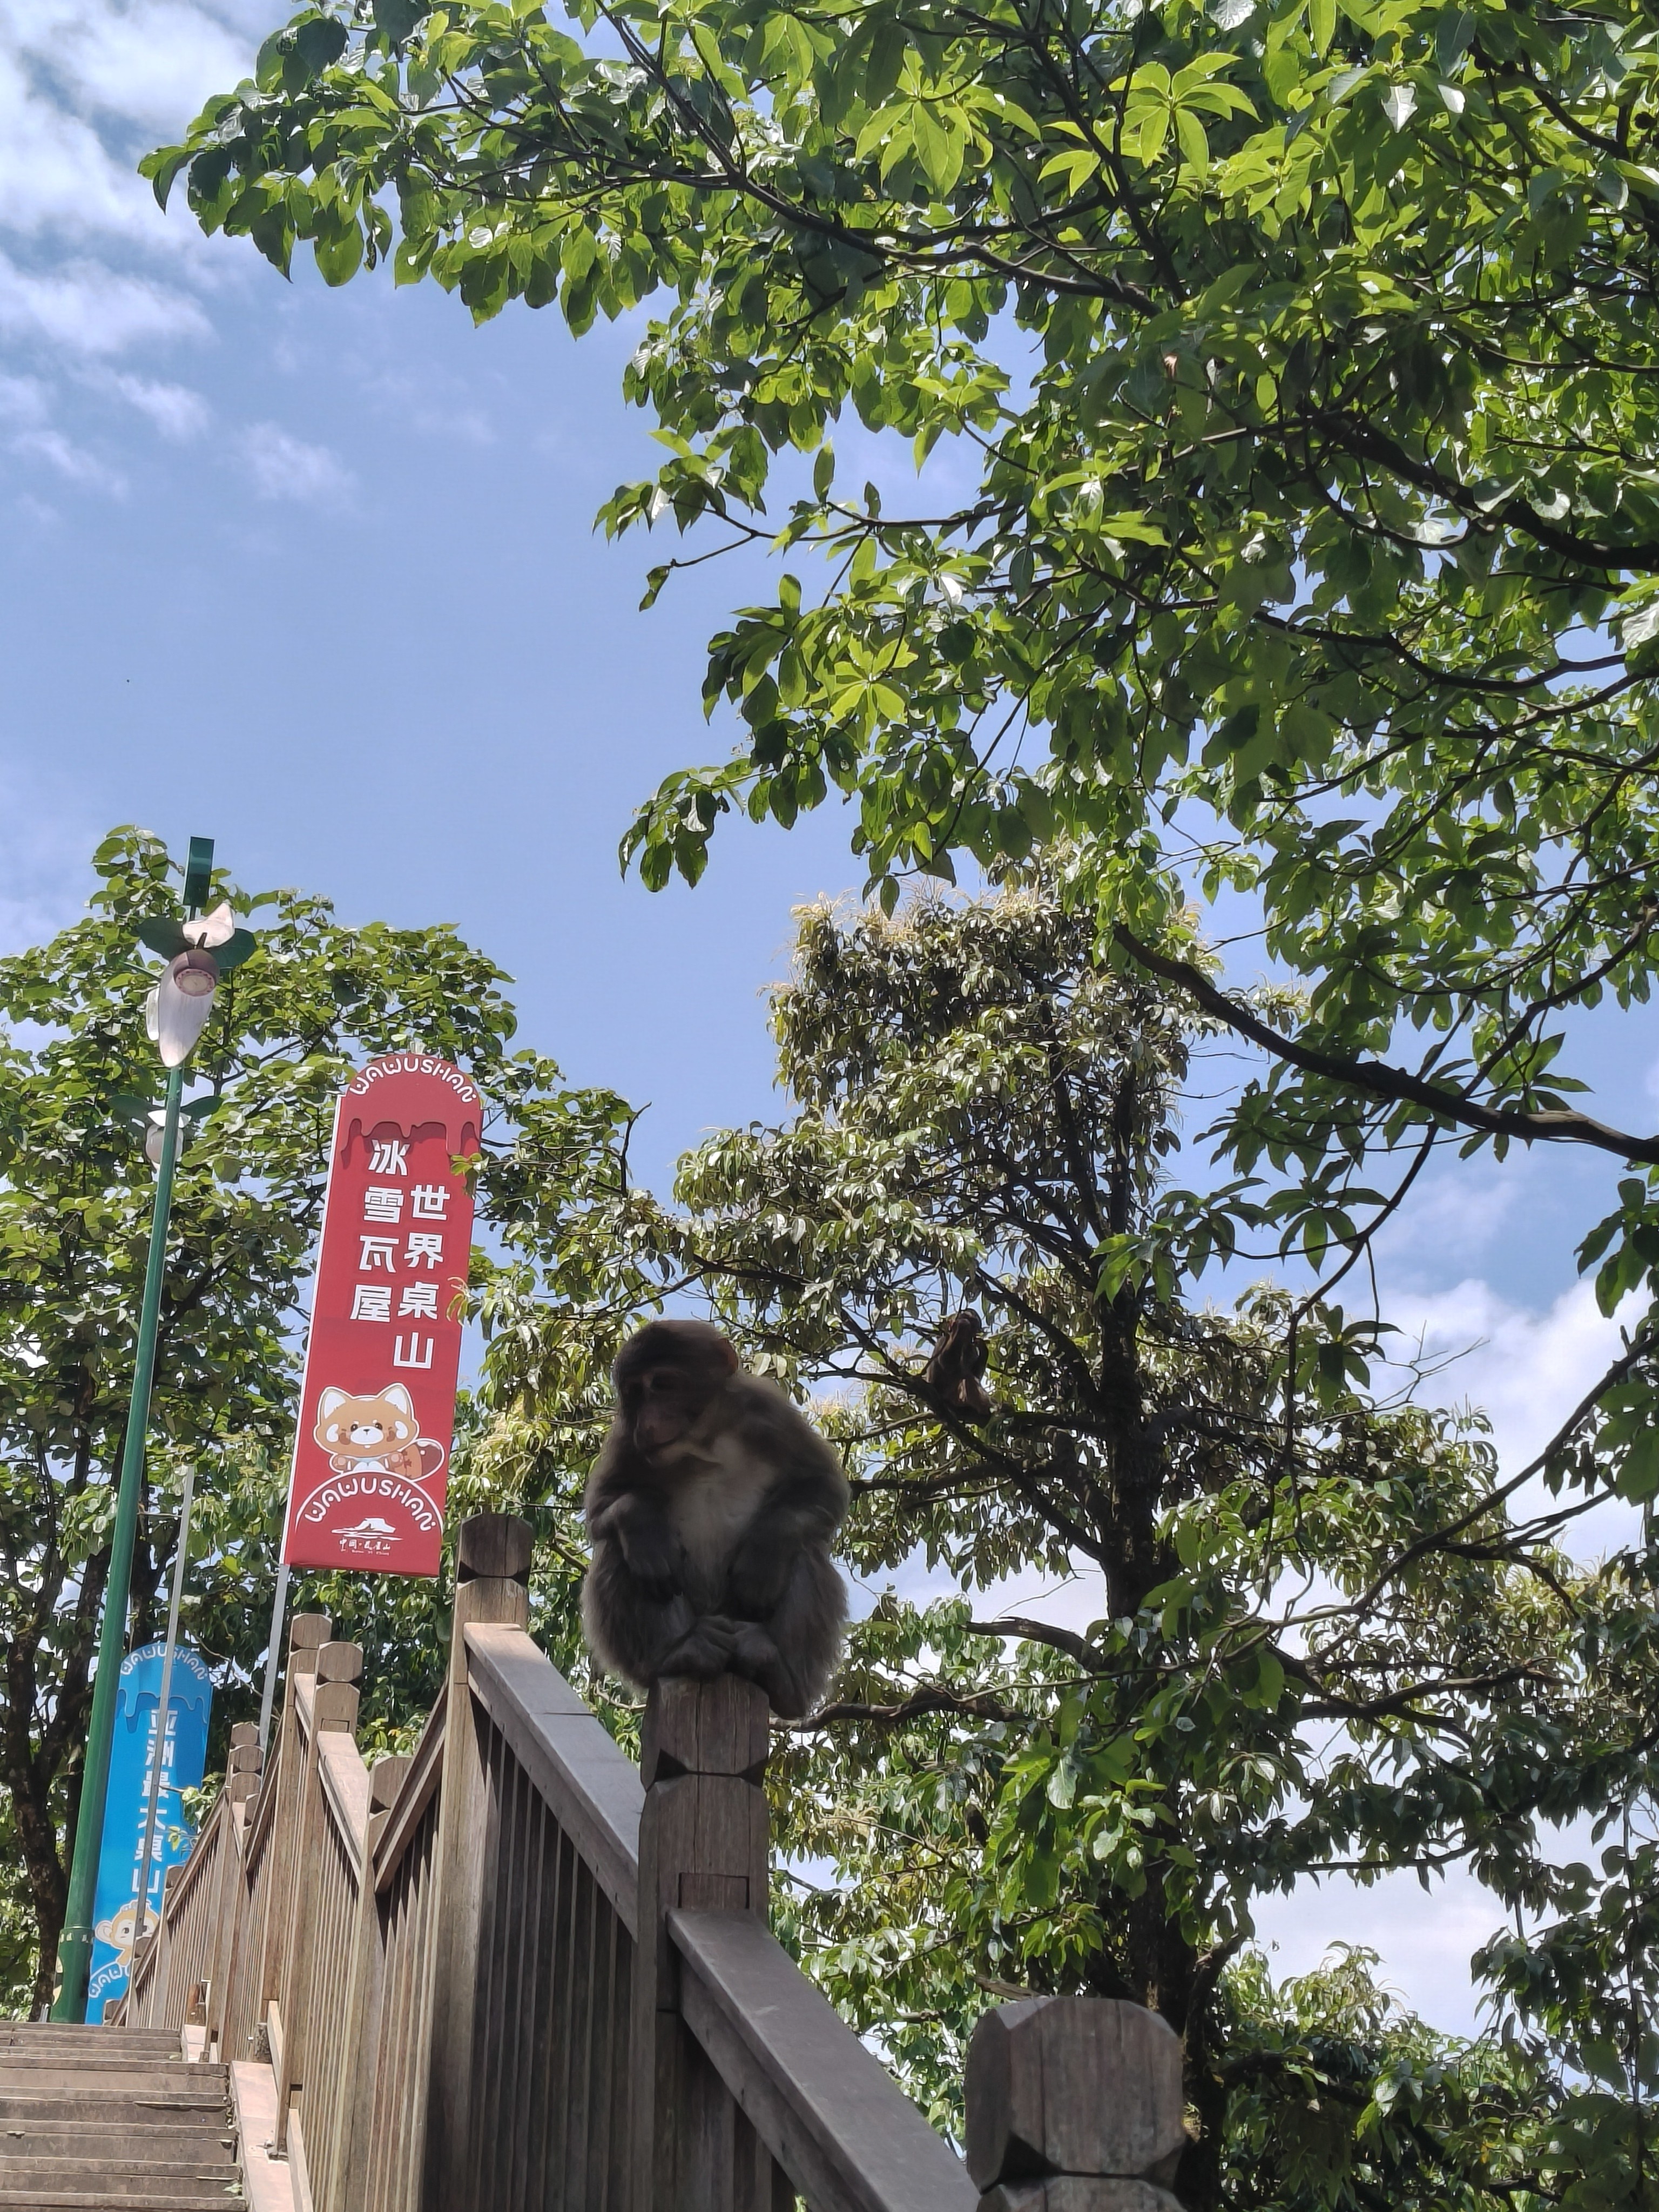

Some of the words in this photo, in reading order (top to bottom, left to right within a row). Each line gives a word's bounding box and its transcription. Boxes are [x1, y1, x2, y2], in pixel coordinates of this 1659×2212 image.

[349, 1057, 476, 1103] WAWUSHAN
[350, 1139, 410, 1323] 冰雪瓦屋
[393, 1184, 450, 1370] 世界桌山
[305, 1478, 436, 1531] WAWUSHAN
